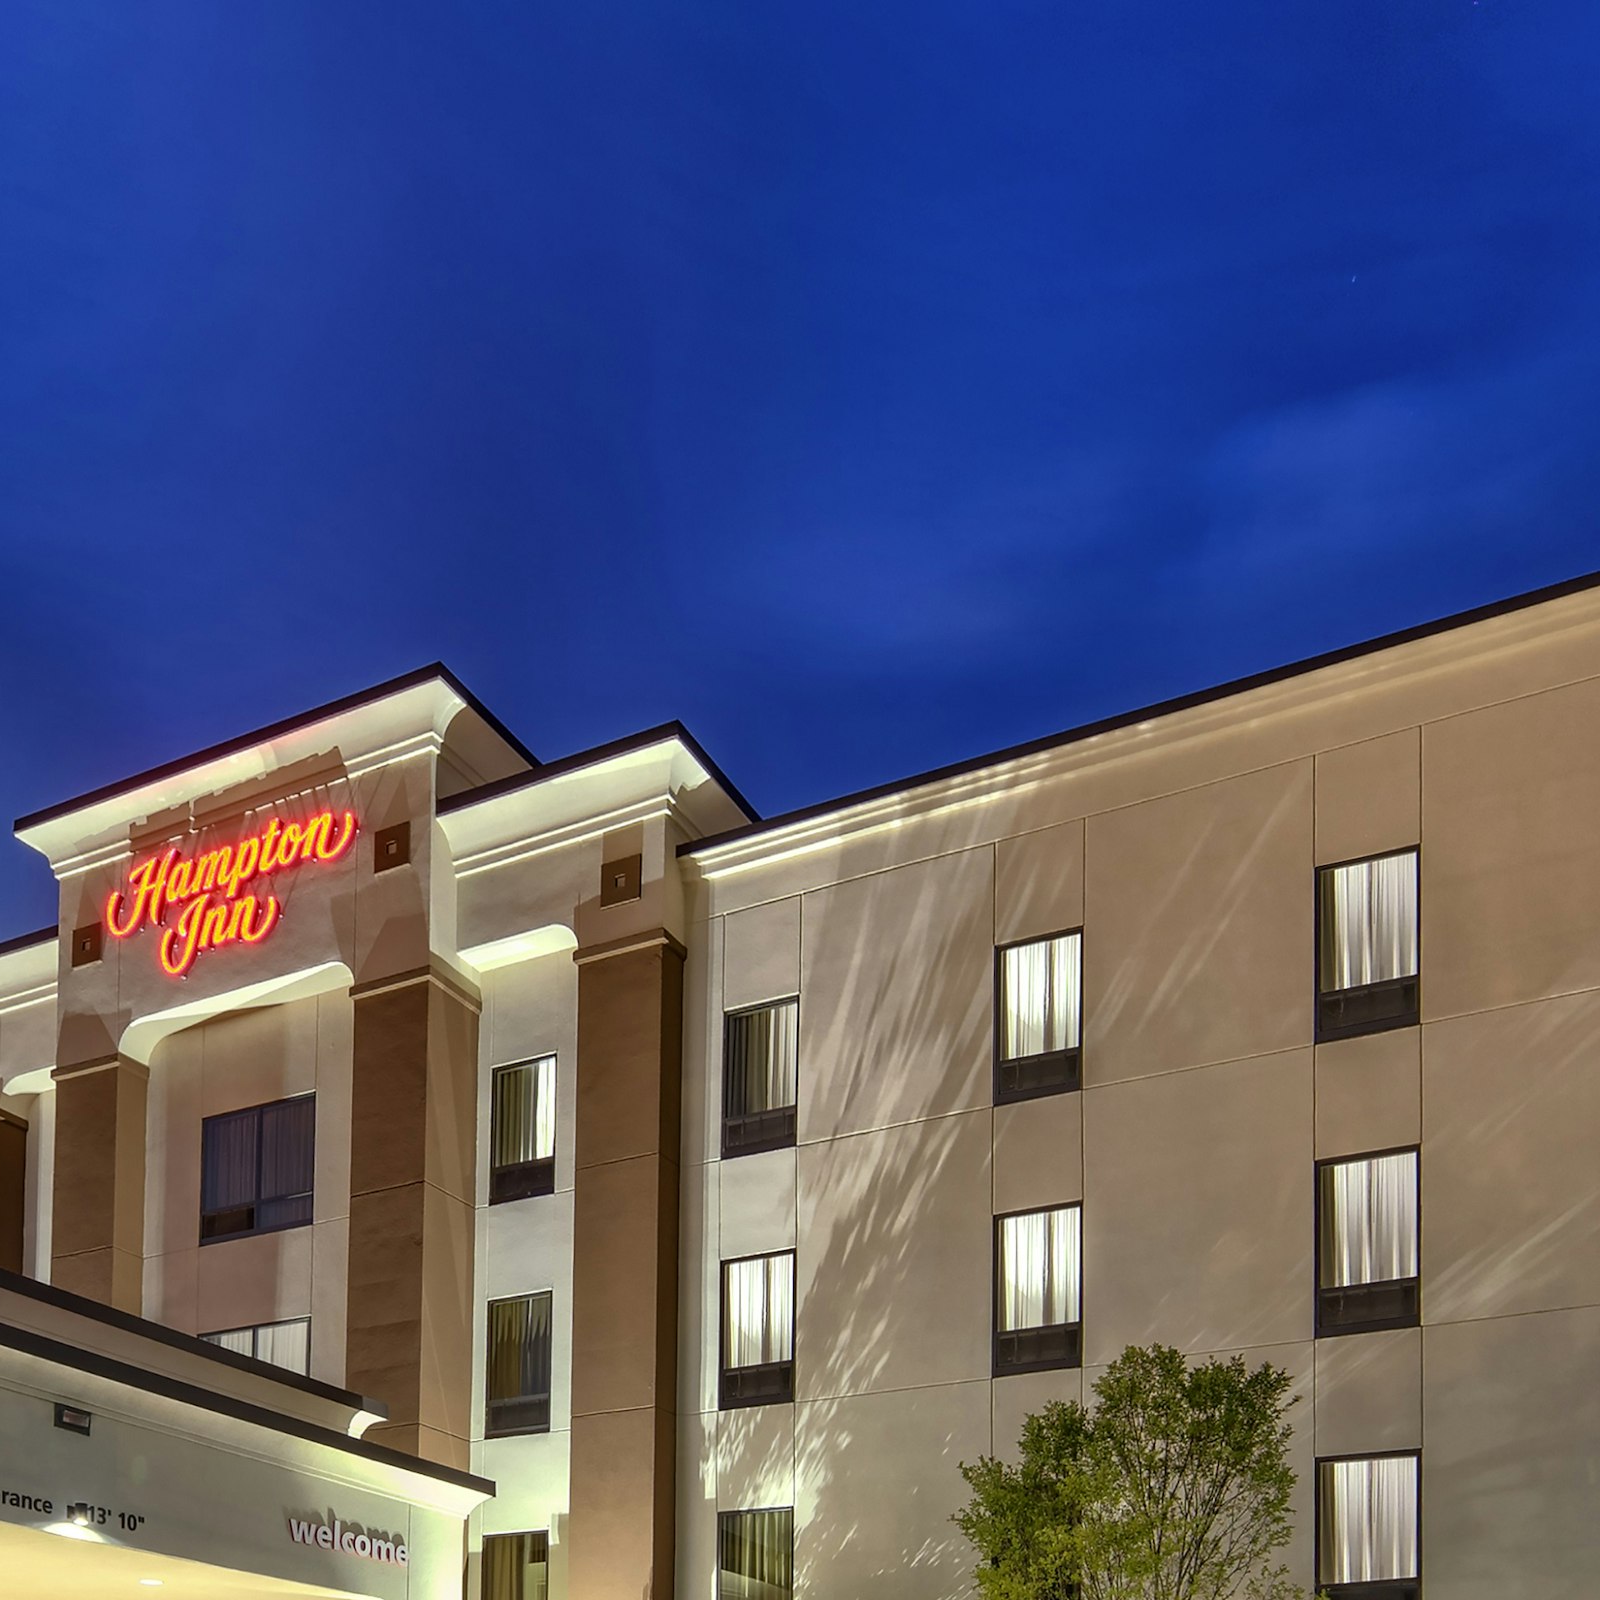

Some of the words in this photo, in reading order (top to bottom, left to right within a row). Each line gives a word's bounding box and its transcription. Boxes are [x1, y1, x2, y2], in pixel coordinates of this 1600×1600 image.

[105, 809, 360, 939] Hampton
[159, 893, 281, 977] Inn
[118, 1512, 145, 1531] 10"
[289, 1518, 410, 1568] welcome
